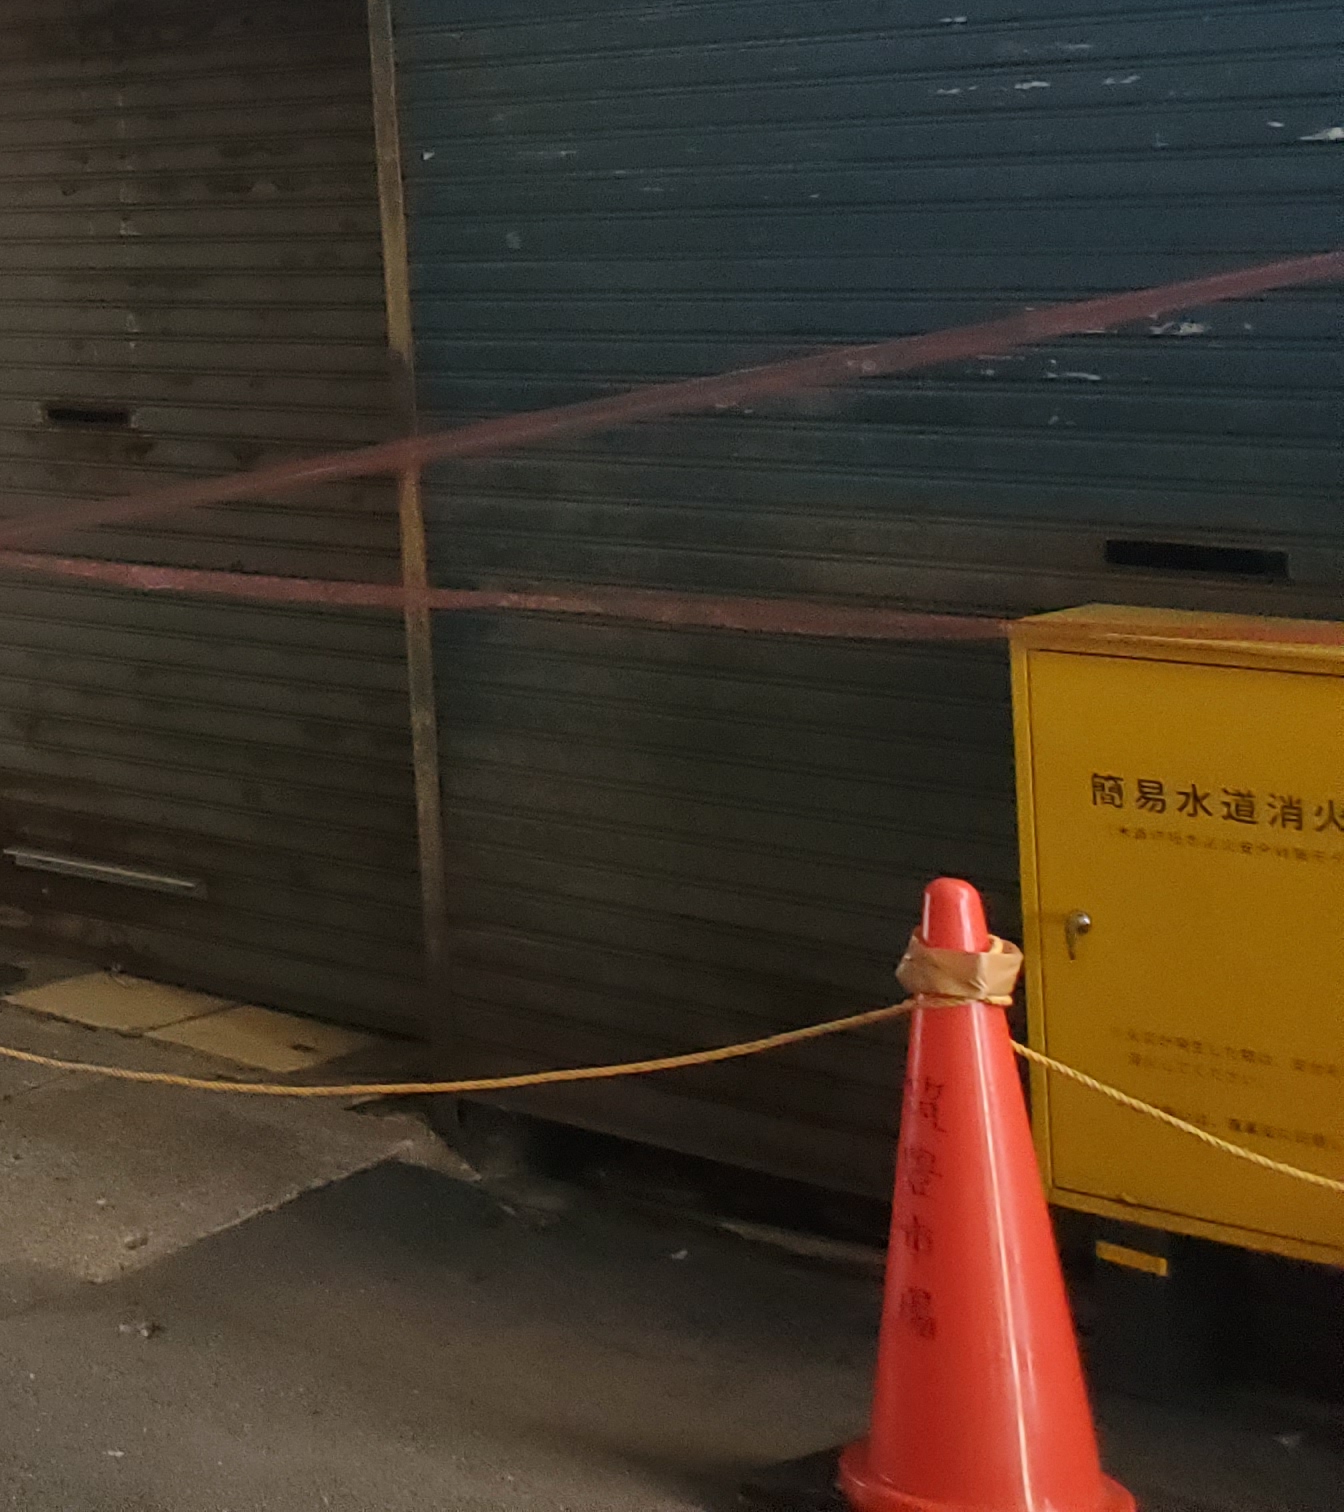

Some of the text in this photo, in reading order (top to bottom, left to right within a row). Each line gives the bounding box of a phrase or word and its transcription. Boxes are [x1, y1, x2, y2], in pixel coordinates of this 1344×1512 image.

[1091, 773, 1343, 831] 簡易水道消火
